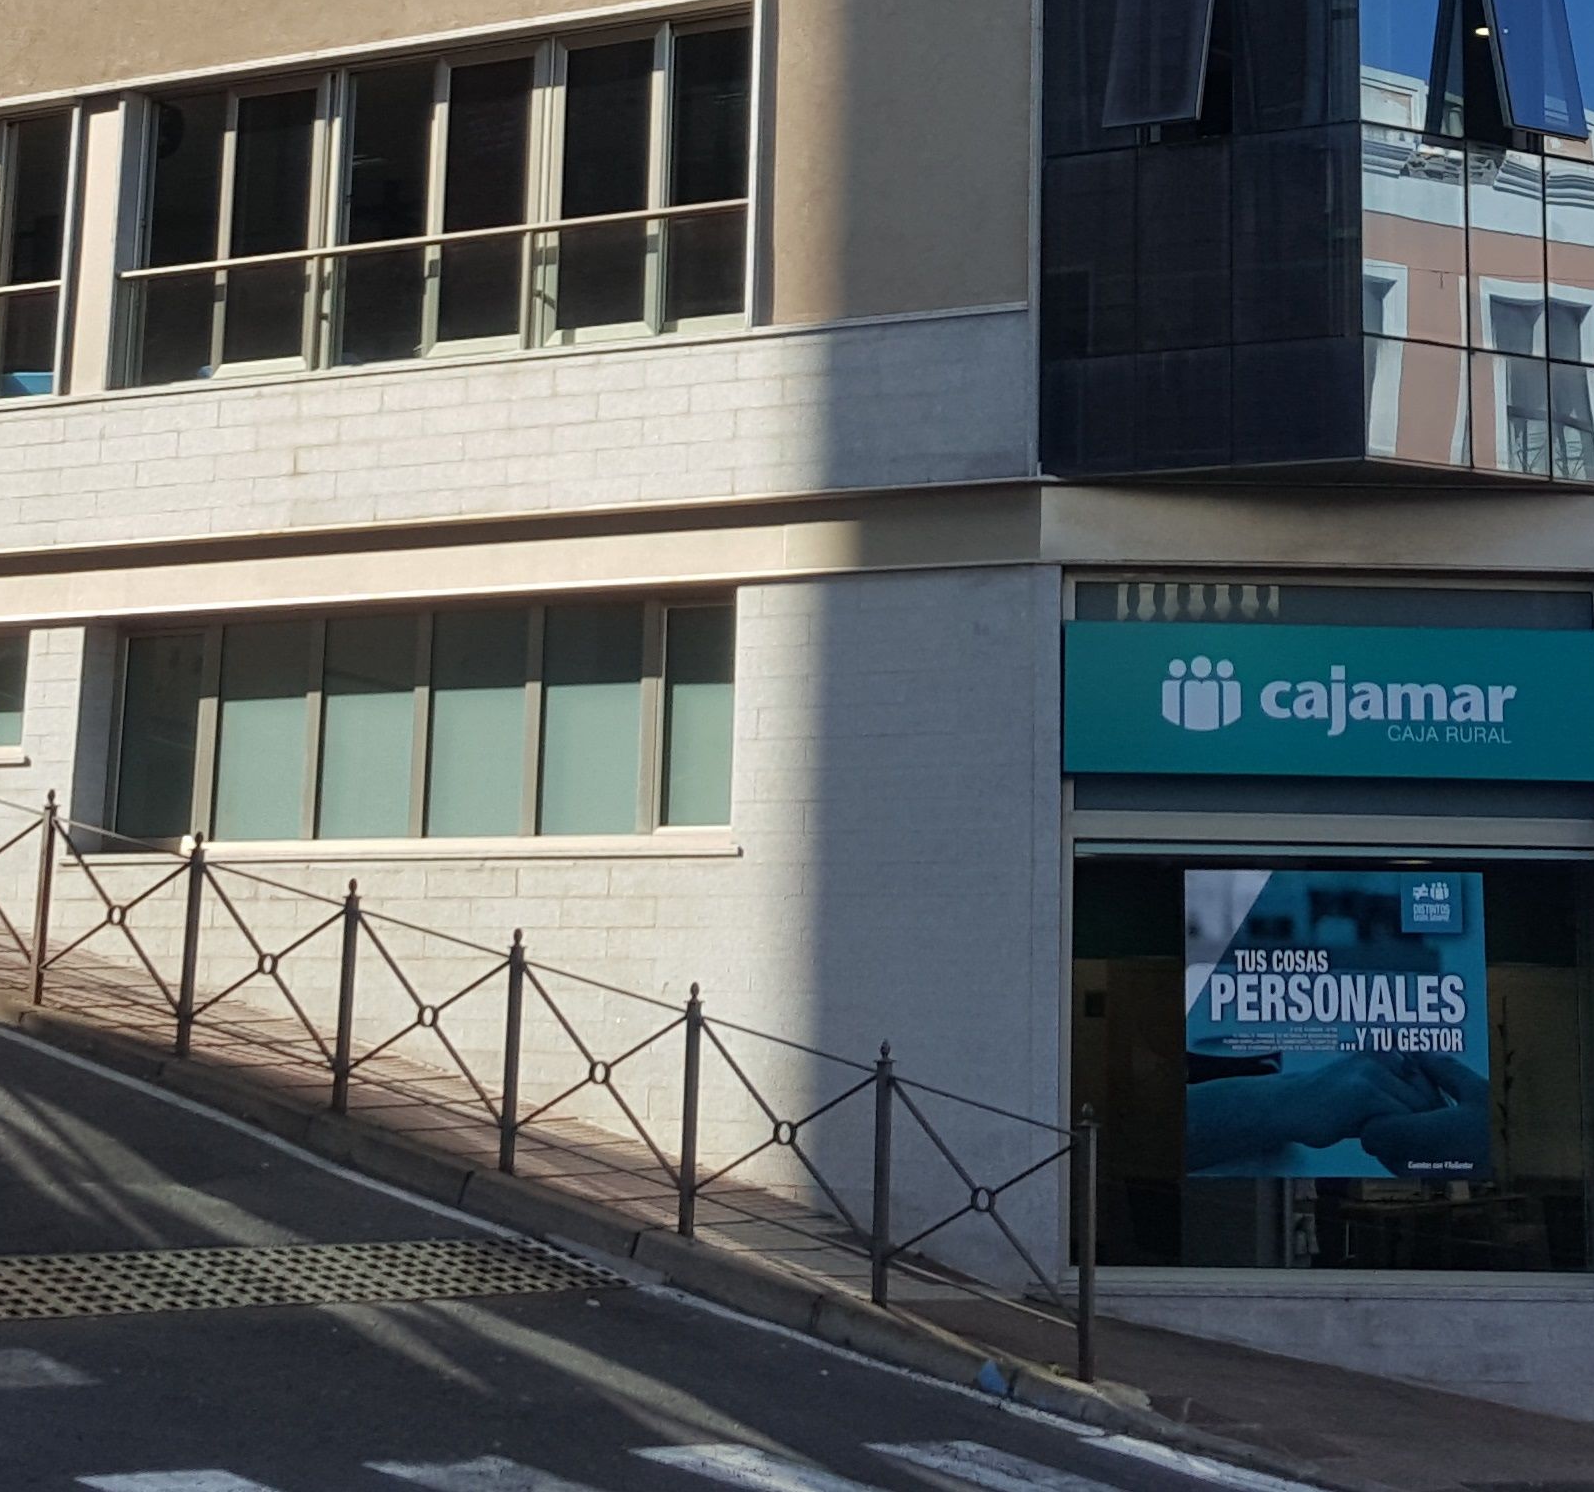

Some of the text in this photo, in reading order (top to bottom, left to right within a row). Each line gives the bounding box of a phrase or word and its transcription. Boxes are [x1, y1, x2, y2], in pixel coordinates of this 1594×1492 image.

[1259, 664, 1518, 738] cajamar
[1387, 725, 1512, 745] CAJA RURAL
[1235, 949, 1329, 973] TUS COSAS
[1210, 973, 1467, 1024] PERSONALES
[1370, 1028, 1393, 1052] TU
[1397, 1027, 1464, 1053] GESTOR
